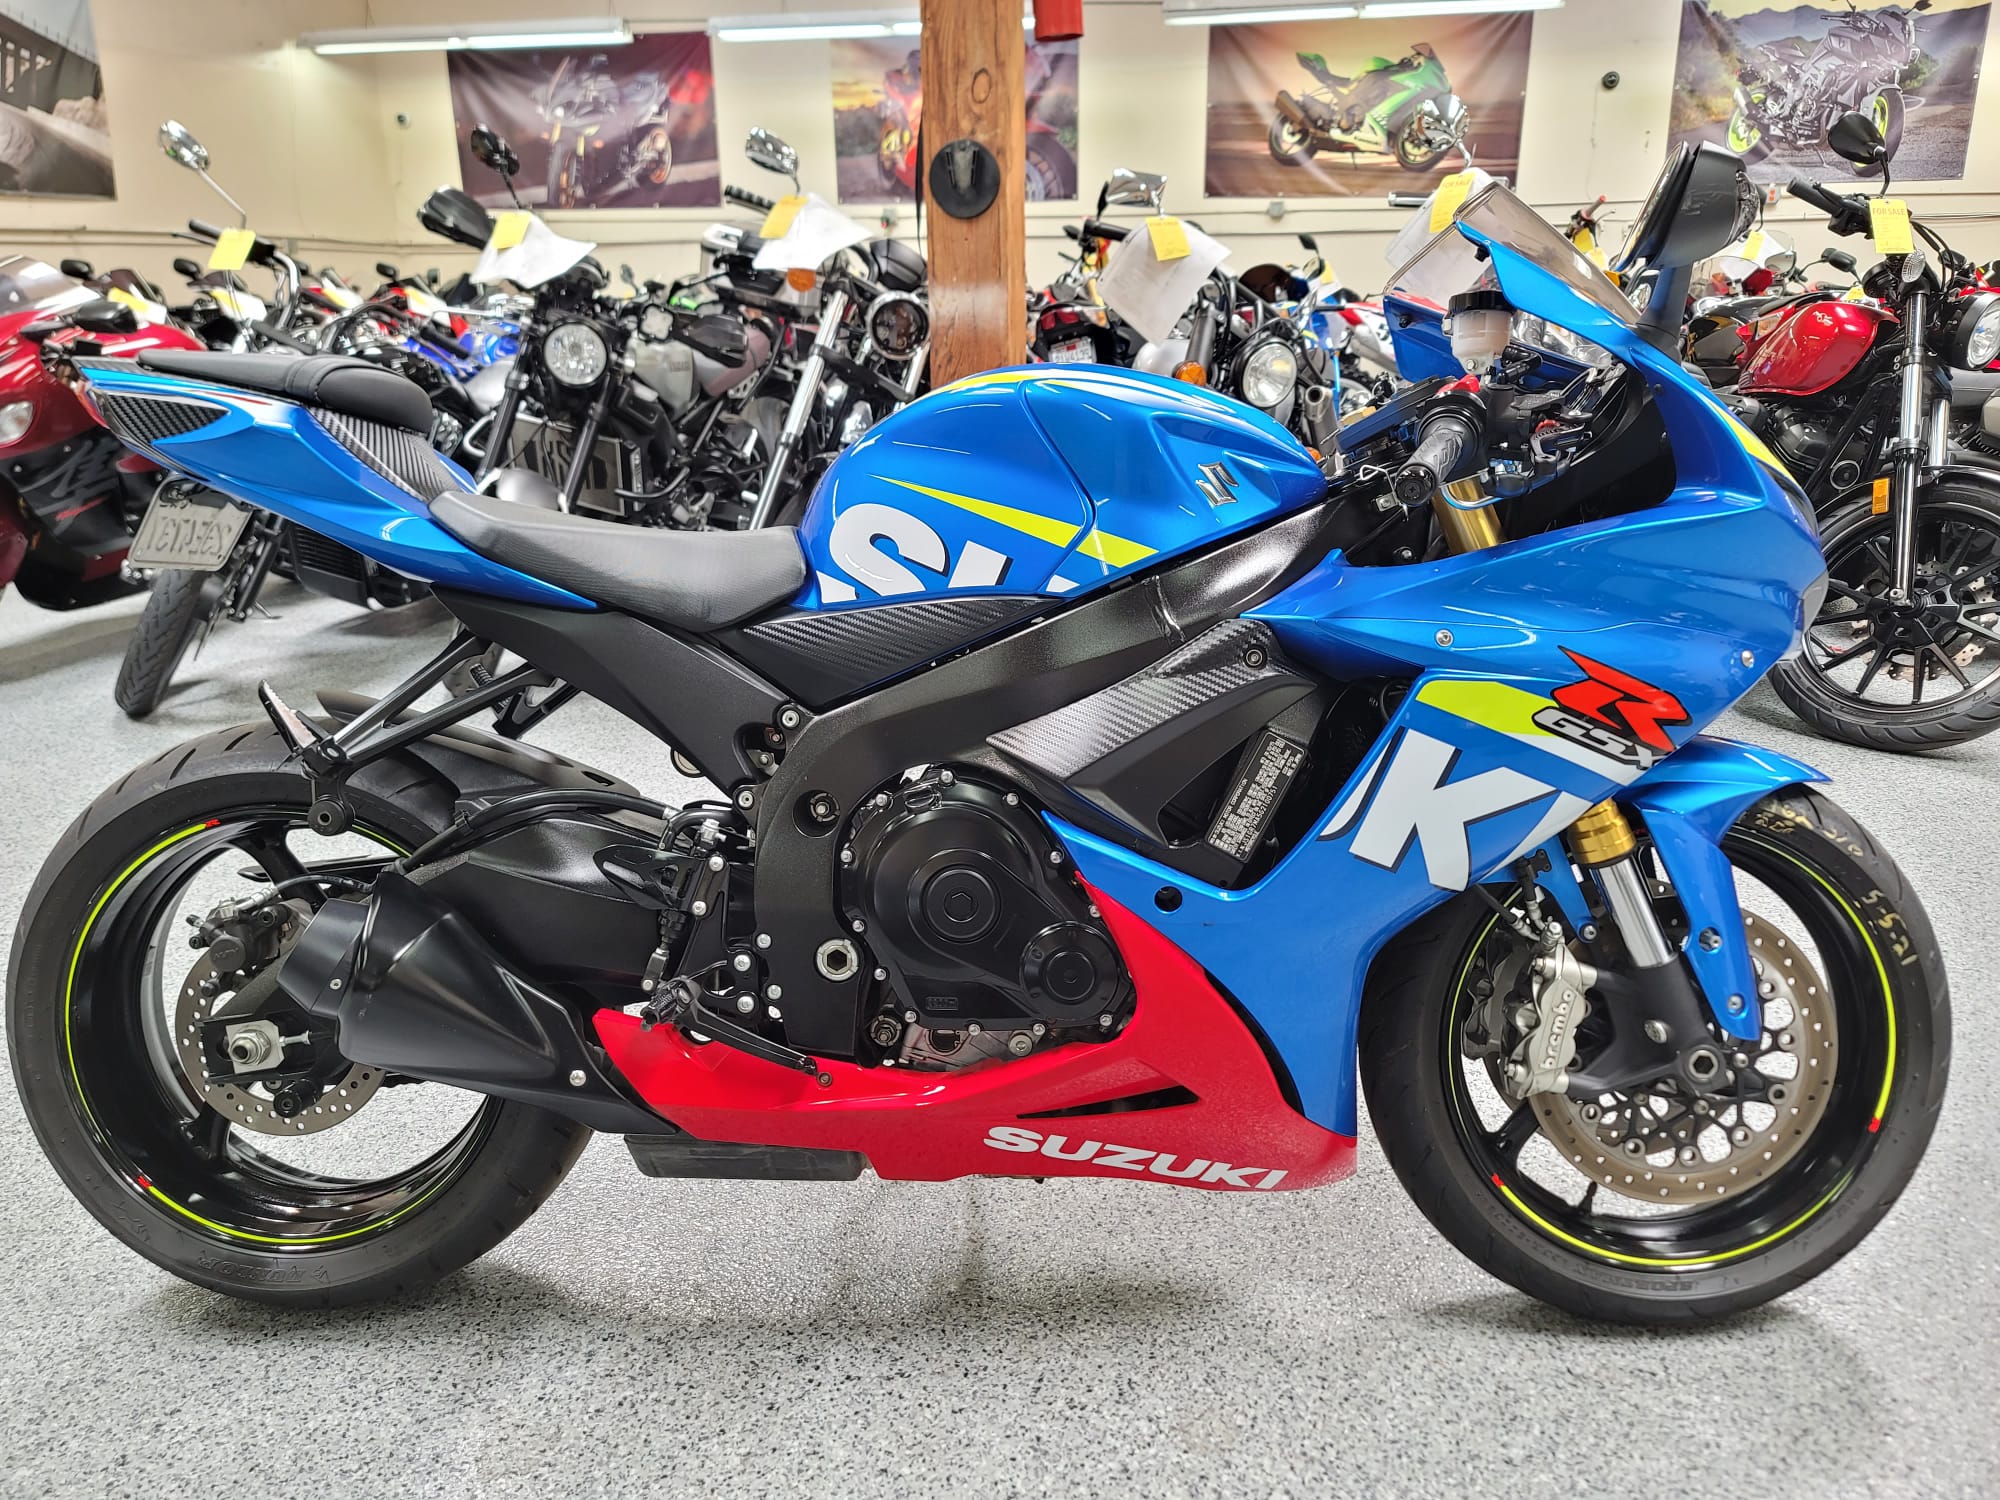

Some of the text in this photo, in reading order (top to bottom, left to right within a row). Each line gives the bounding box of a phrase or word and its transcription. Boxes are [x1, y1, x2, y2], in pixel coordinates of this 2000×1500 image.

[1872, 207, 1906, 217] FOR SALE
[1538, 989, 1577, 1070] brembo
[983, 1126, 1289, 1190] SUZUKI
